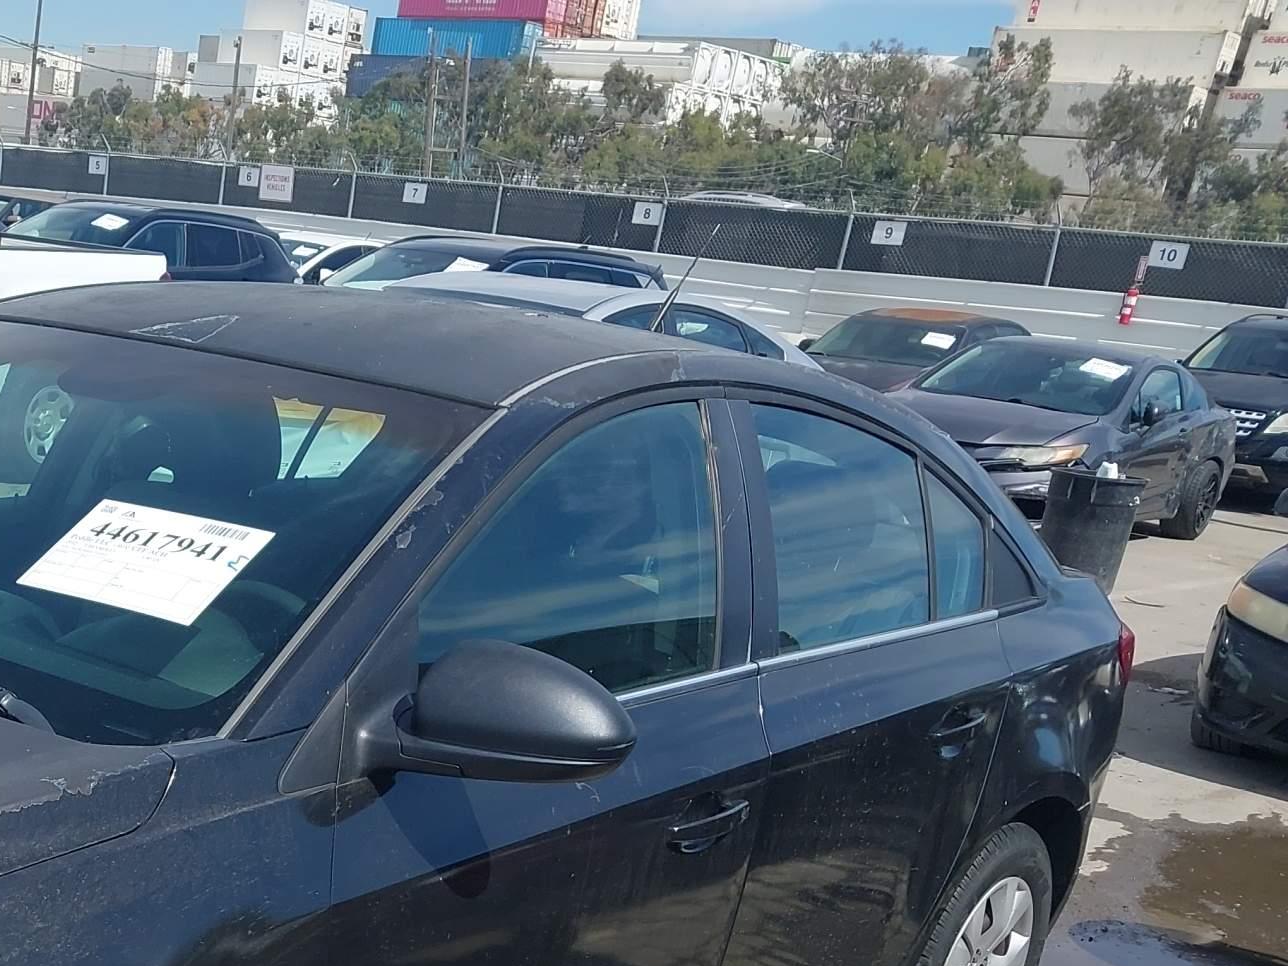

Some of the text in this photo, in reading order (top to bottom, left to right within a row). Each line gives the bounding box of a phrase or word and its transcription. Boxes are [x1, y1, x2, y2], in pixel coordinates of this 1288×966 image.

[1261, 35, 1288, 44] seac
[1229, 92, 1262, 101] seaco
[31, 100, 57, 120] ON
[95, 160, 101, 170] 5
[246, 171, 252, 182] 6
[412, 187, 419, 198] 7
[643, 207, 651, 220] 8
[884, 226, 894, 239] 9
[1159, 247, 1178, 262] 10
[90, 521, 228, 562] 44617941
